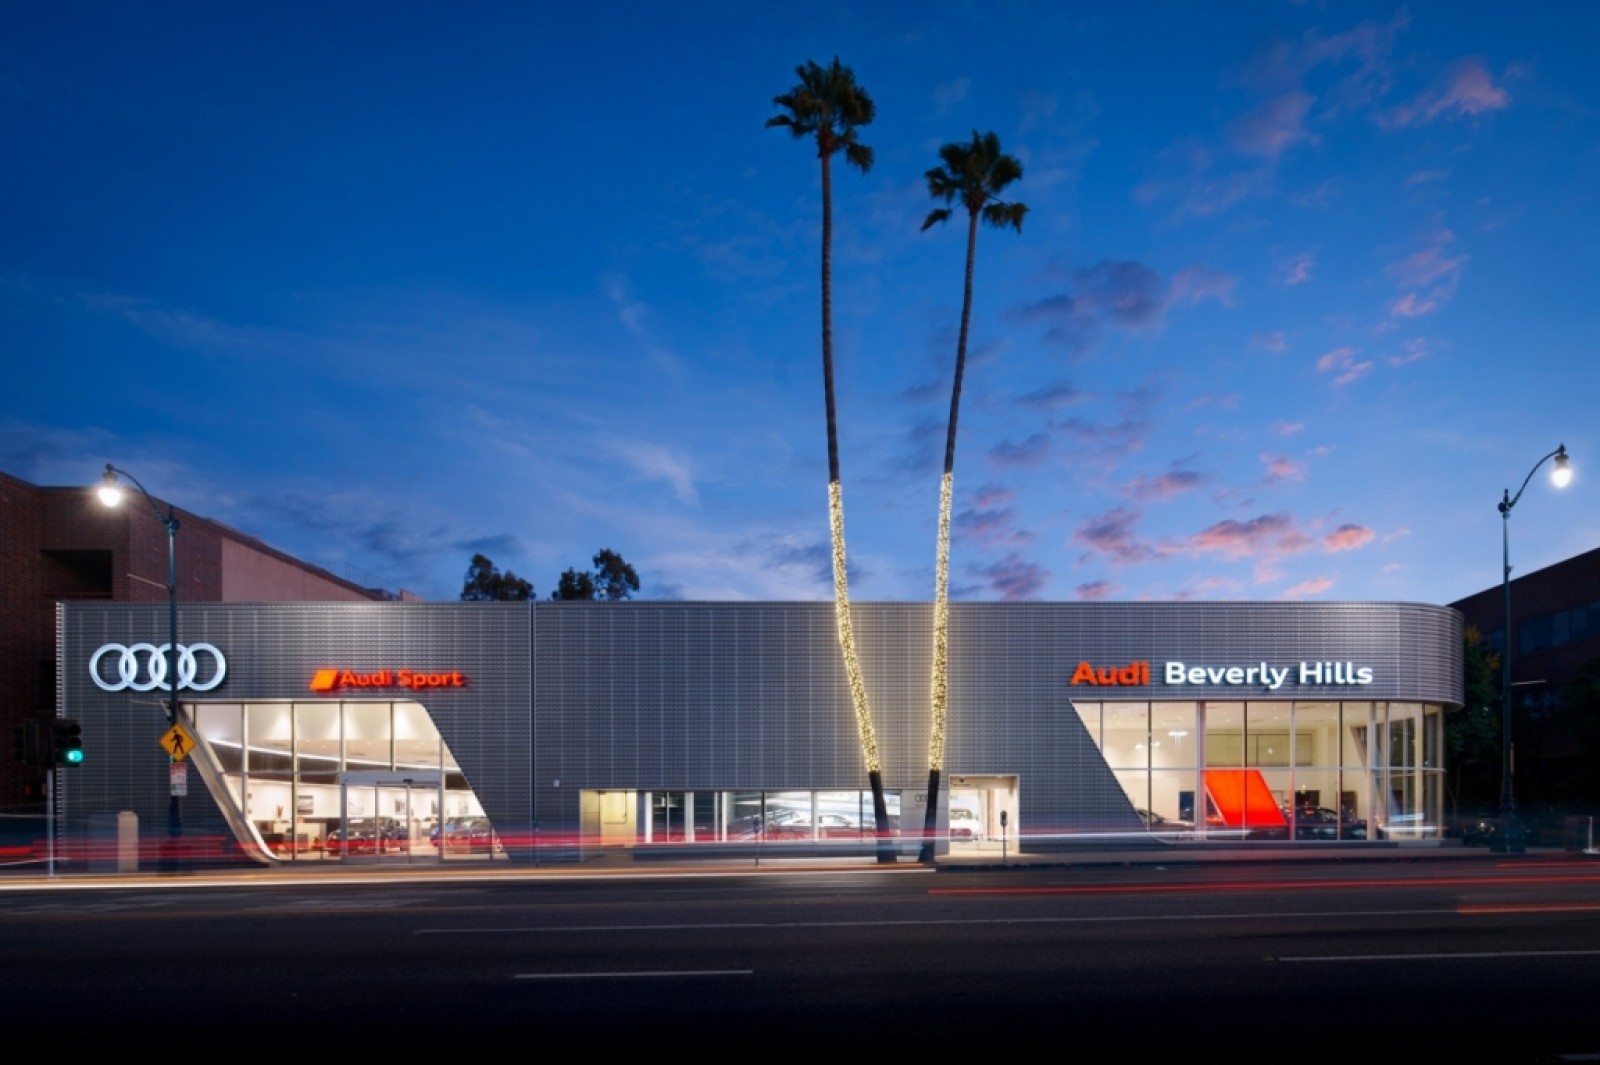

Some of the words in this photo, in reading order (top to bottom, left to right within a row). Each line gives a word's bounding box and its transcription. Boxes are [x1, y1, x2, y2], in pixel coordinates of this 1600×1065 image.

[340, 668, 392, 686] Audi
[397, 668, 464, 689] Sport
[1070, 660, 1150, 686] Audi
[1164, 661, 1290, 690] Beverly
[1300, 661, 1373, 685] Hills
